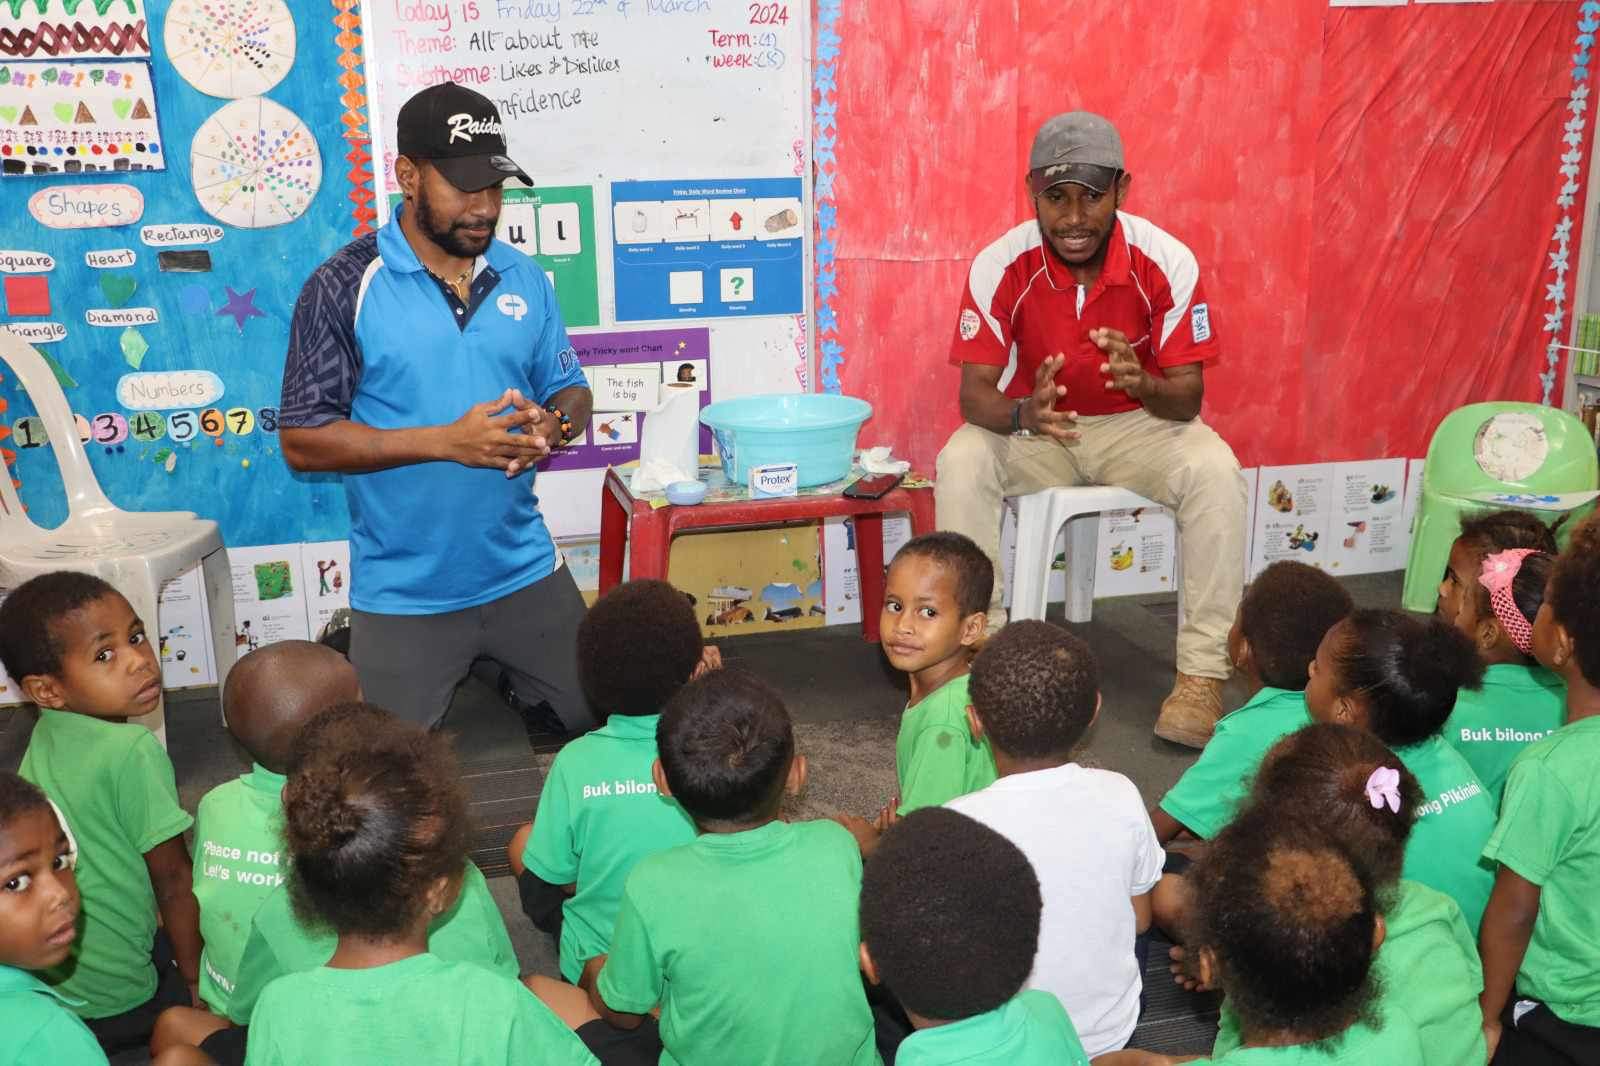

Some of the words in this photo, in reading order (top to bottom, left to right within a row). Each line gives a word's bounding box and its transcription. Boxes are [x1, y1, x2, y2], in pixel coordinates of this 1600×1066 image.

[748, 2, 790, 26] 2024
[392, 29, 457, 55] Theme:
[469, 30, 495, 52] All
[504, 25, 564, 51] about
[500, 60, 543, 82] Likes
[498, 87, 583, 120] nfidence
[49, 193, 122, 217] Shapes
[143, 226, 224, 244] Rectangle
[508, 225, 527, 244] u
[87, 250, 135, 265] Heart
[86, 310, 157, 322] Diamond
[130, 381, 205, 402] Numbers
[606, 376, 624, 389] The
[627, 377, 645, 389] fish
[622, 388, 637, 402] big
[18, 421, 40, 449] 1
[99, 414, 119, 443] 3
[136, 409, 156, 439] 4
[171, 413, 193, 439] 5
[201, 409, 219, 433] 6
[228, 411, 248, 434] 7
[260, 408, 277, 432] 8
[760, 474, 791, 486] Protex
[1460, 727, 1493, 742] Buk
[583, 781, 612, 799] Buk
[614, 779, 659, 796] bilon
[236, 869, 287, 888] work
